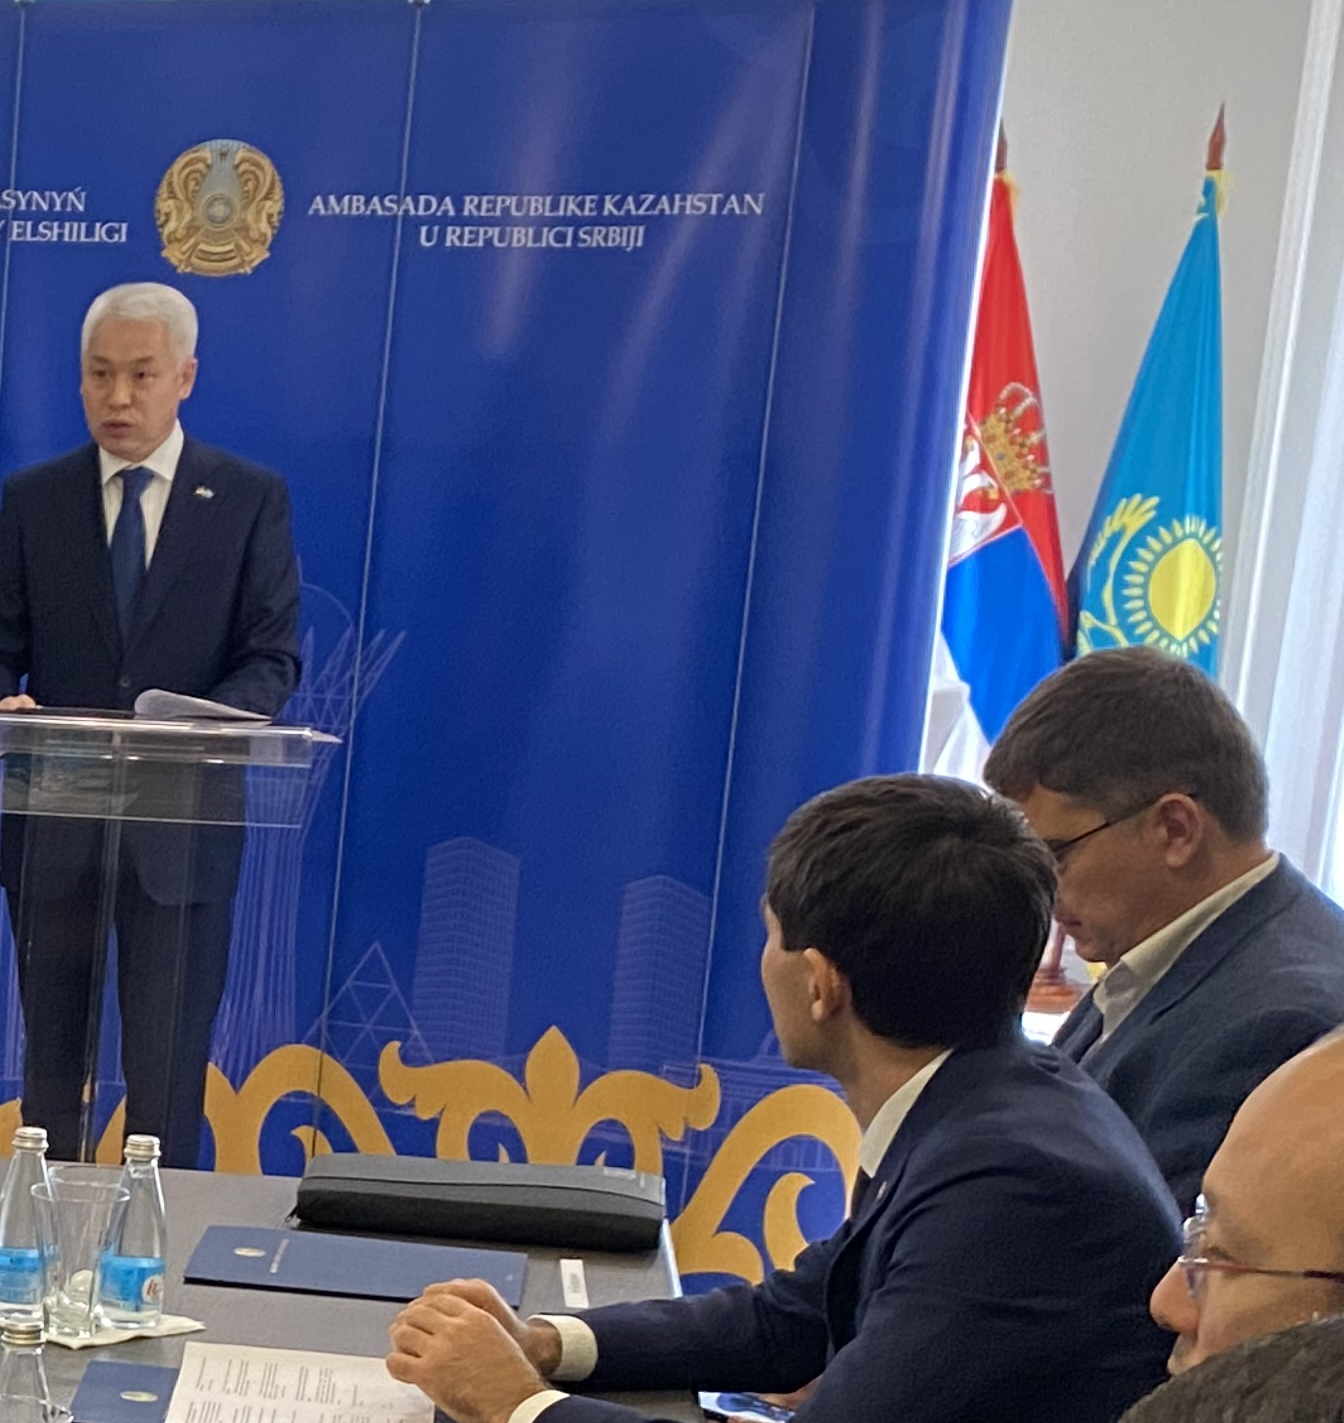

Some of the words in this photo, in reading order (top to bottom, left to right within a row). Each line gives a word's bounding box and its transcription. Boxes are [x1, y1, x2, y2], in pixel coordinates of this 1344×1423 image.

[308, 194, 456, 216] AMBASADA
[463, 194, 598, 217] REPUBLIKE
[602, 193, 766, 216] KAZAHSTAN
[10, 220, 129, 243] ELSHILIGI
[419, 225, 440, 247] U
[444, 225, 575, 248] REPUBLICI
[577, 225, 646, 252] SRBIJI
